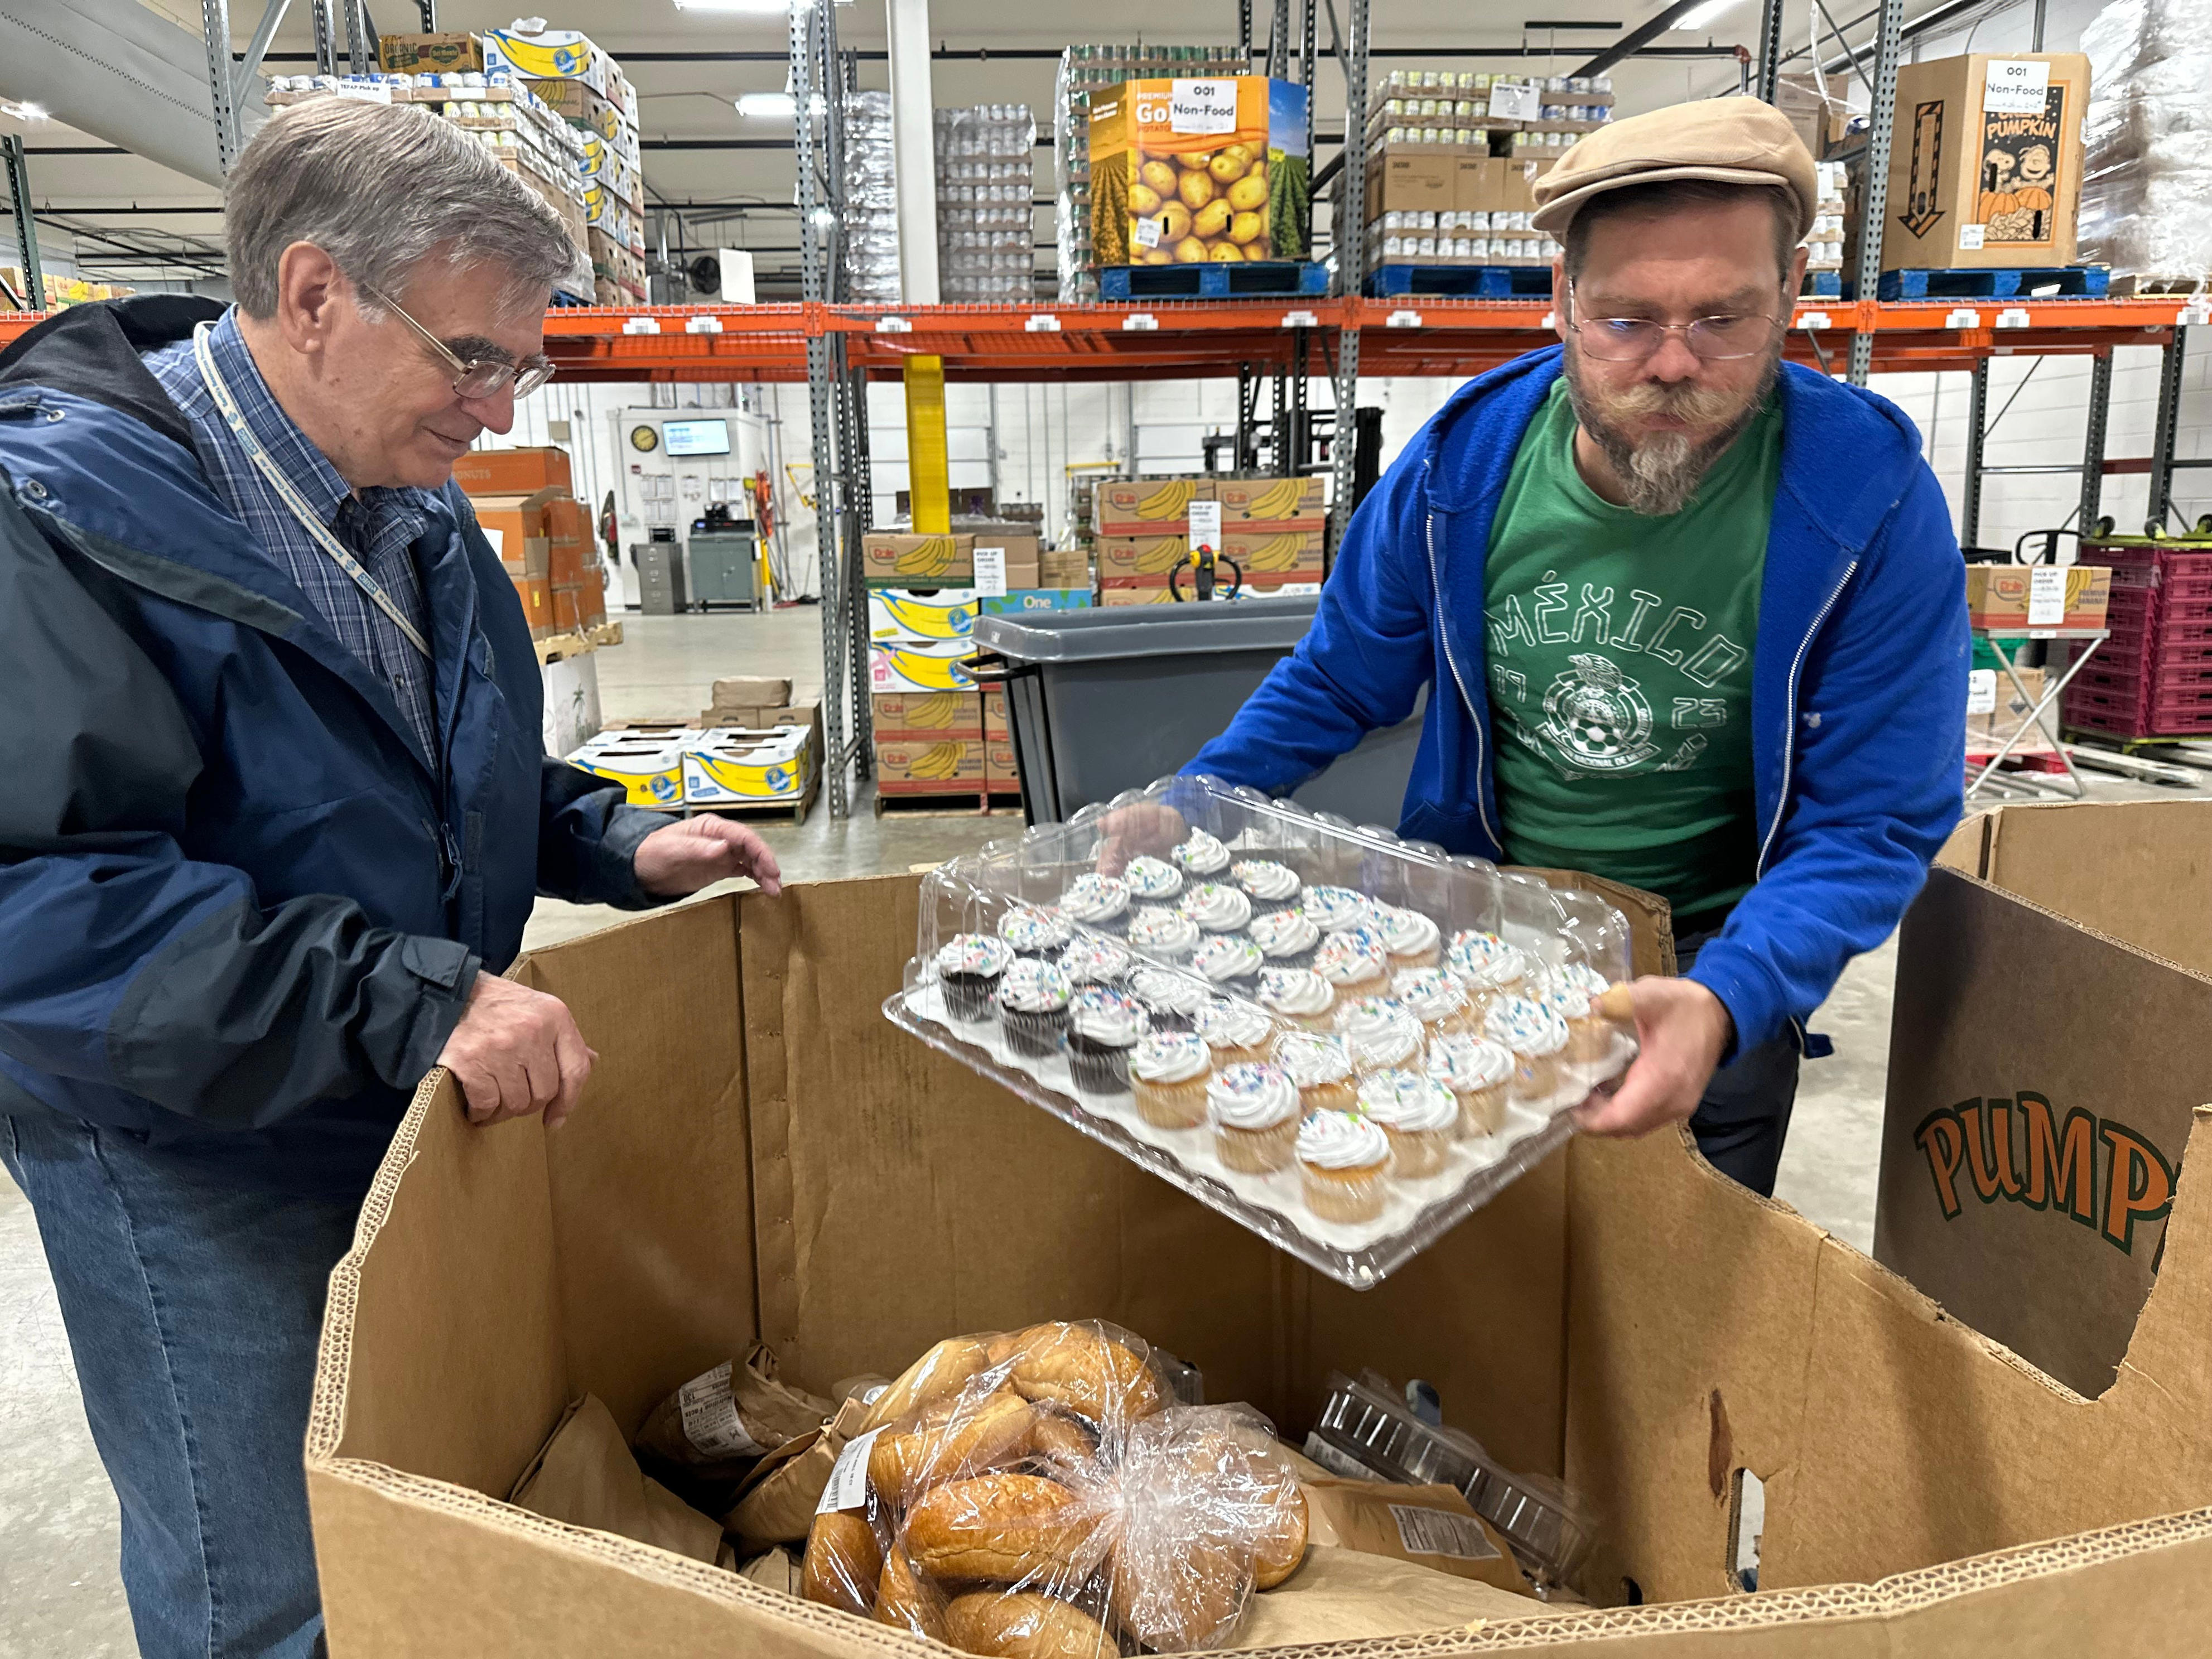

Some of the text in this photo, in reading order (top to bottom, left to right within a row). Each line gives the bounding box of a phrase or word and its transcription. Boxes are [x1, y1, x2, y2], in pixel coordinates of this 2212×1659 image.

[2006, 66, 2027, 76] 001
[1193, 86, 1215, 96] 001
[1987, 83, 2044, 96] Non-Food
[1136, 101, 1172, 123] Gol
[1174, 103, 1234, 116] Non-Food
[1987, 119, 2057, 140] PUMPKIN
[1024, 595, 1052, 609] One
[1484, 570, 1747, 688] MÉXICO
[1493, 664, 1526, 703] 19
[1914, 1091, 2179, 1275] PUMP
[683, 1392, 696, 1402] 130
[685, 1407, 703, 1417] Facts
